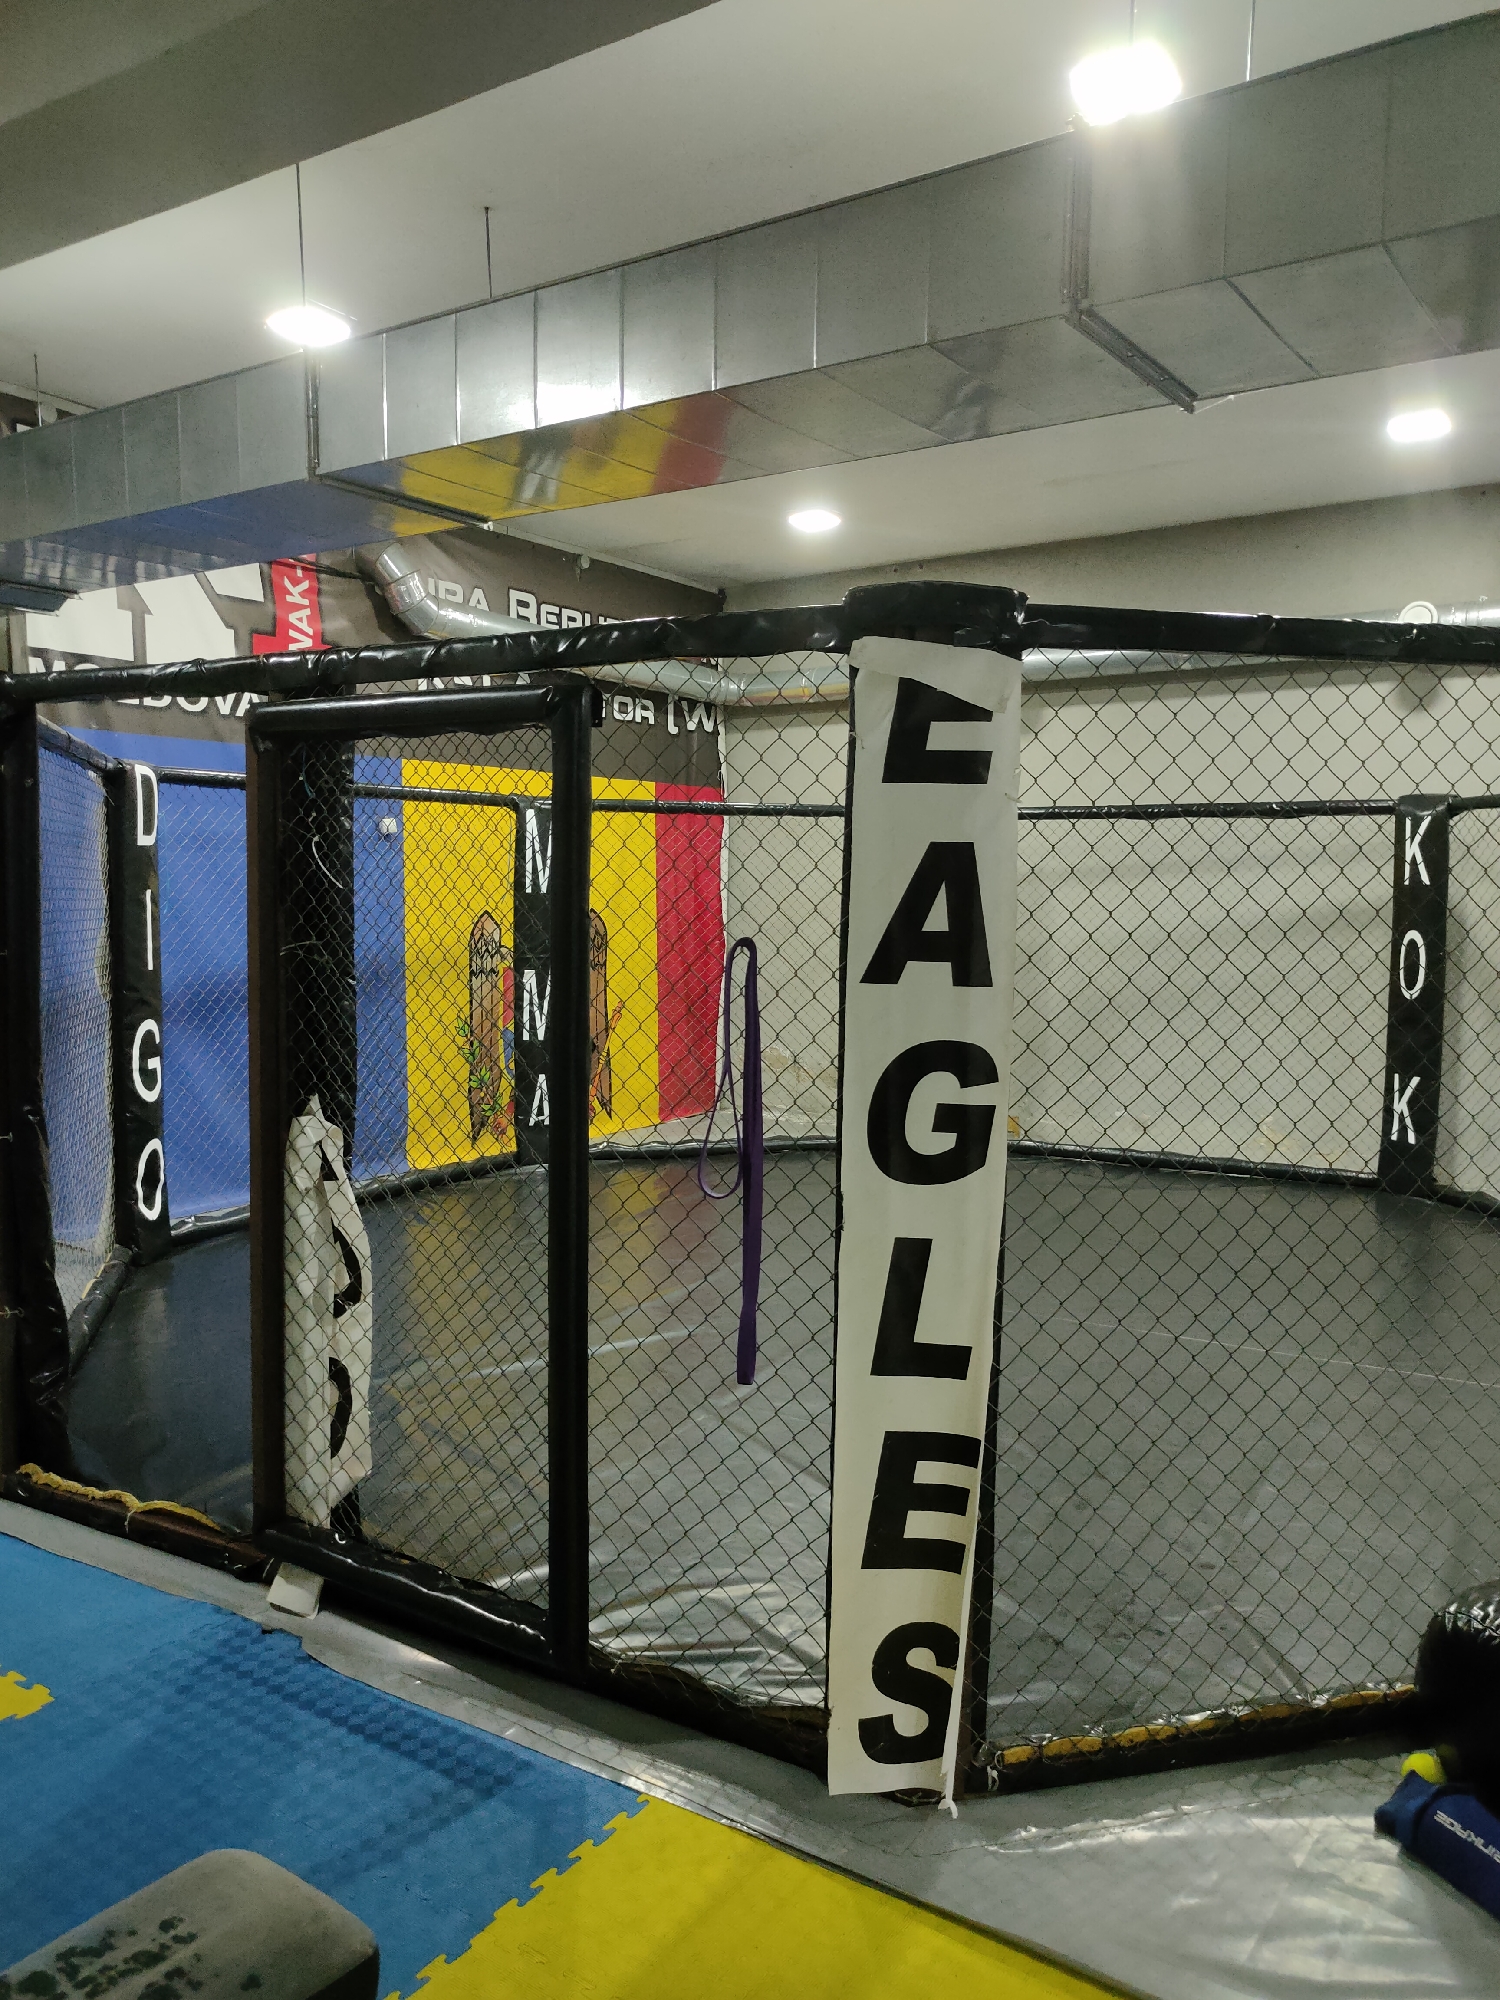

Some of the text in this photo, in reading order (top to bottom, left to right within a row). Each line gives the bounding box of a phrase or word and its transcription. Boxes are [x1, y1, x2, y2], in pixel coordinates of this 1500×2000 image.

[132, 764, 165, 1222] DIGO
[1390, 815, 1432, 1145] KOK
[858, 676, 1000, 1766] EAGLES
